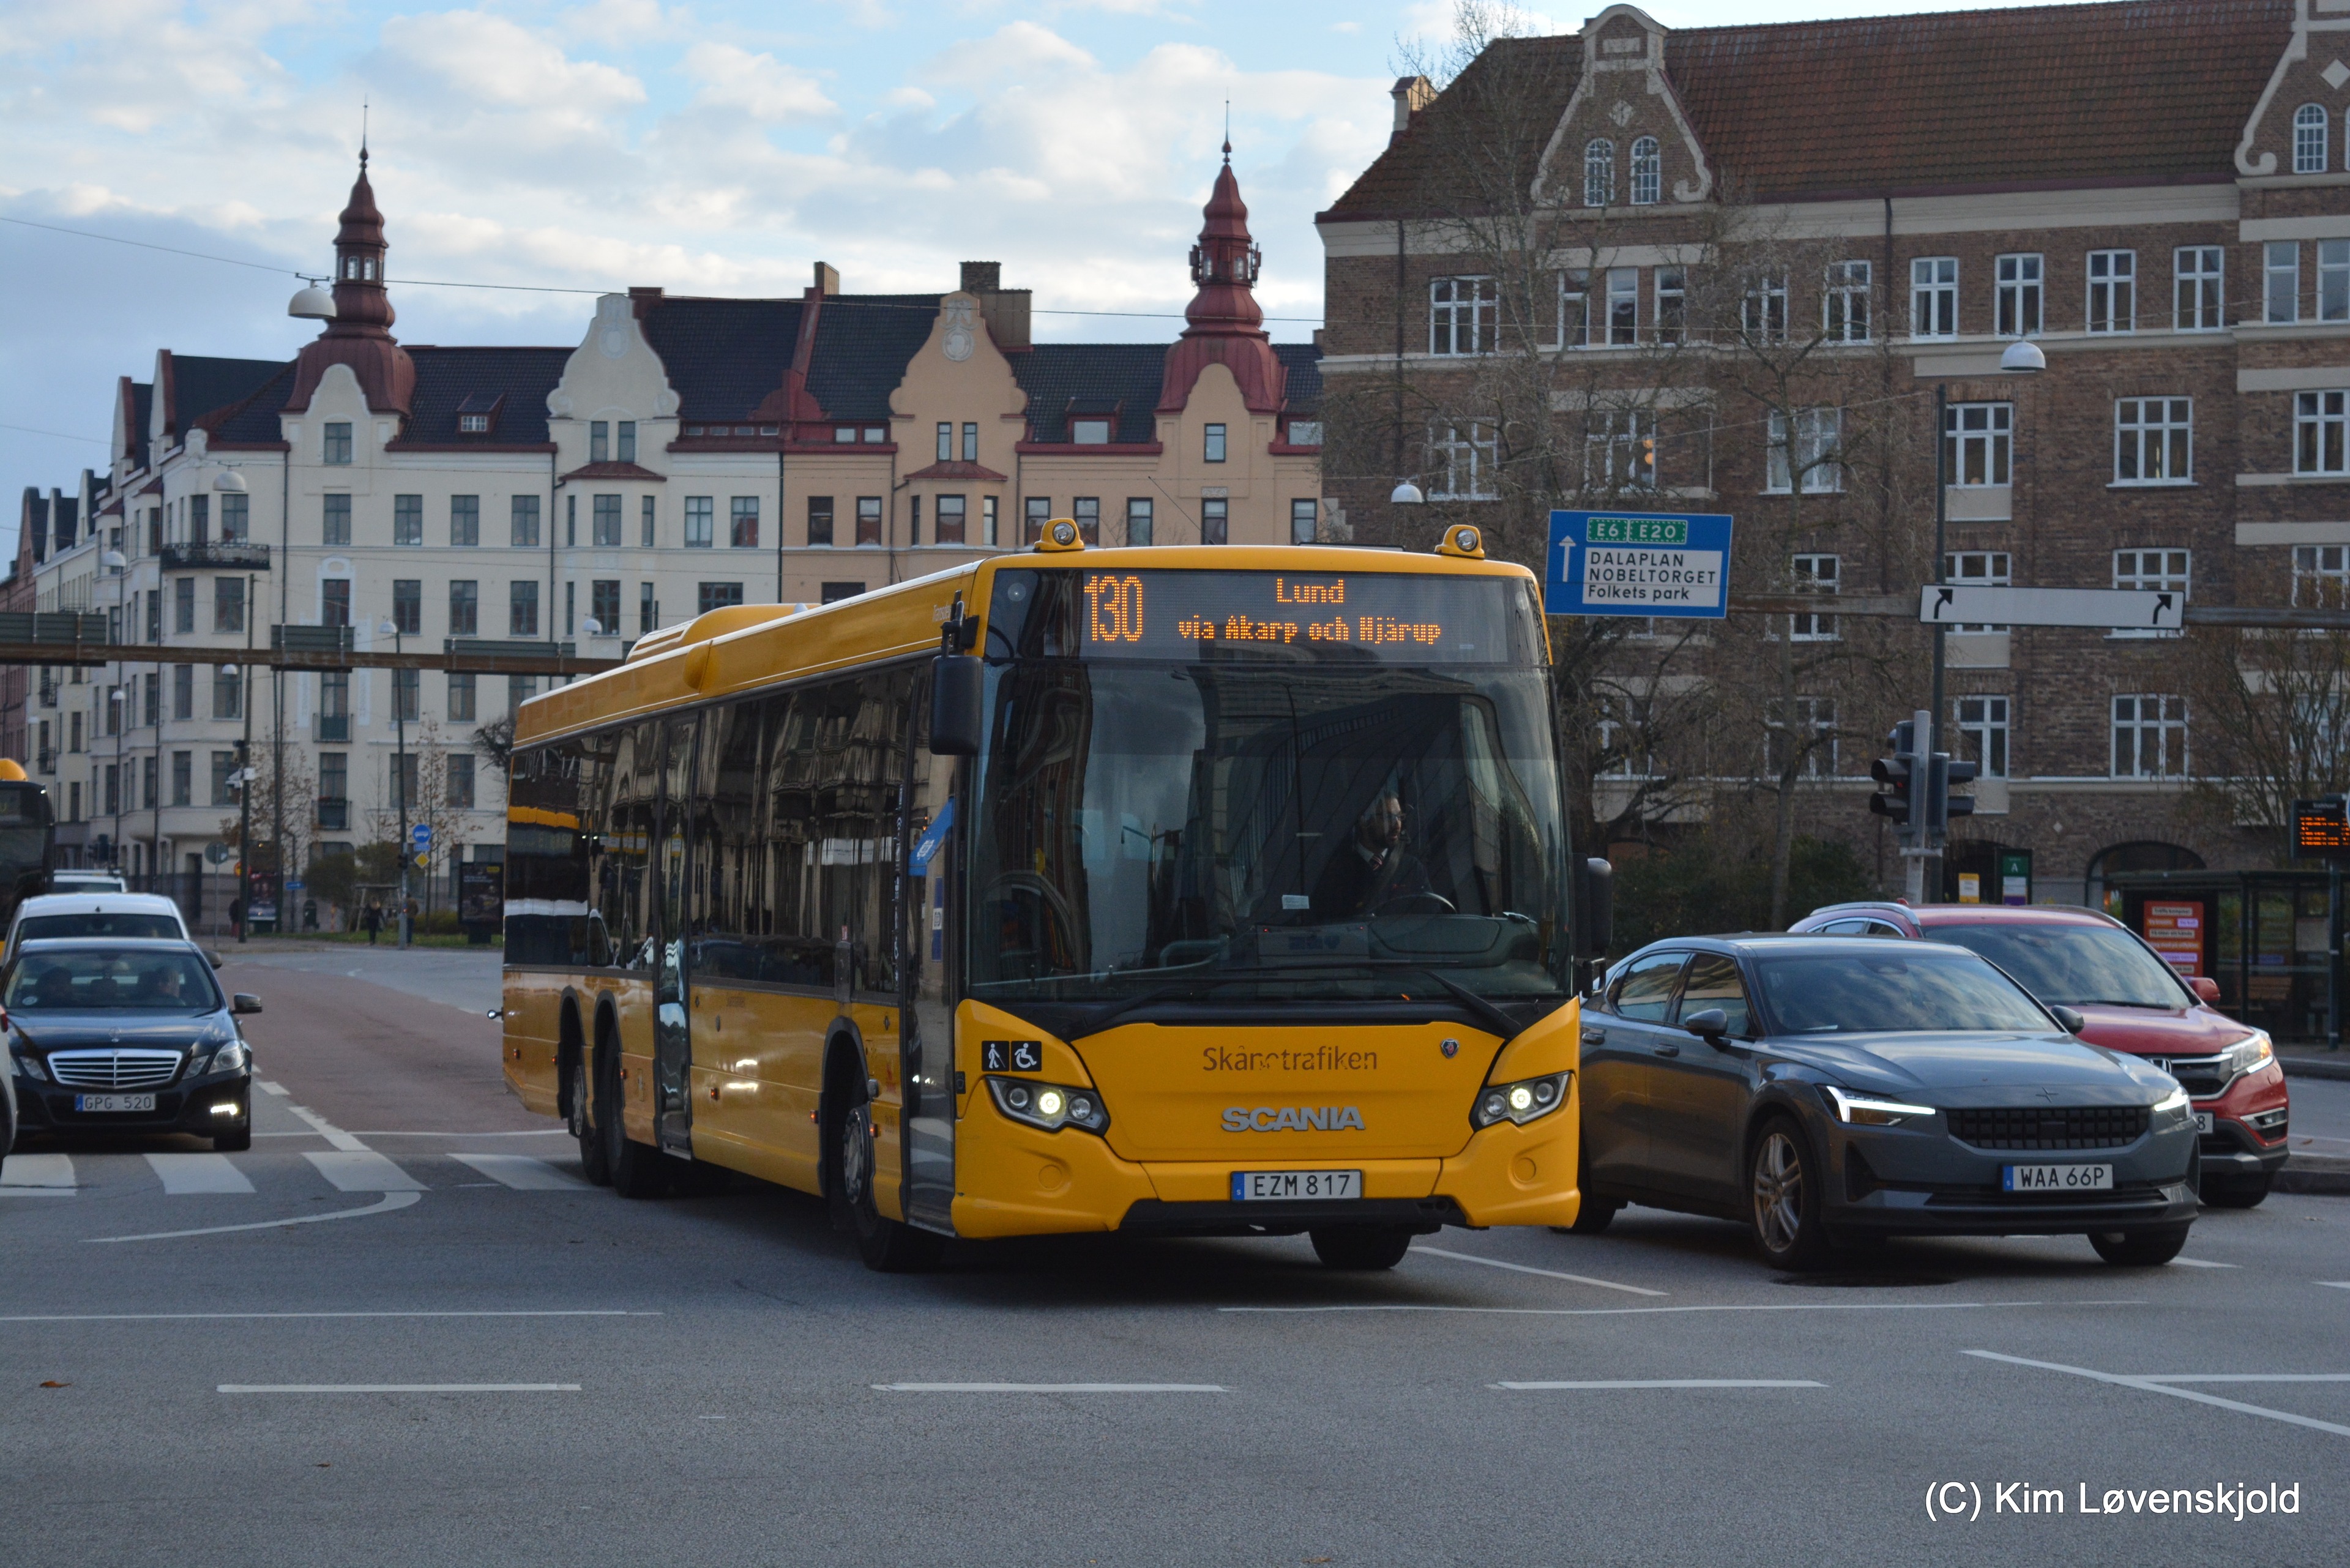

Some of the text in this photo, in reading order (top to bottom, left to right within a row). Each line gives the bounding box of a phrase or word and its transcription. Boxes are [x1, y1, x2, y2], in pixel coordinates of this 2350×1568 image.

[1597, 523, 1619, 537] E6
[1639, 525, 1676, 539] E20
[1590, 551, 1684, 567] DALAPLAN
[1589, 568, 1716, 584] NOBELTORGET
[1277, 578, 1344, 603] Lund
[1588, 584, 1690, 602] Folkets park
[1084, 575, 1142, 641] 130
[1179, 614, 1214, 639] via
[1308, 616, 1349, 640] och
[1359, 617, 1441, 645] Hjärup
[84, 1096, 151, 1110] GPG 520
[1220, 1105, 1366, 1132] SCANIA
[1253, 1176, 1298, 1197] EZM
[1305, 1174, 1350, 1195] 817
[2021, 1168, 2059, 1187] WAA
[2066, 1167, 2105, 1186] 66P
